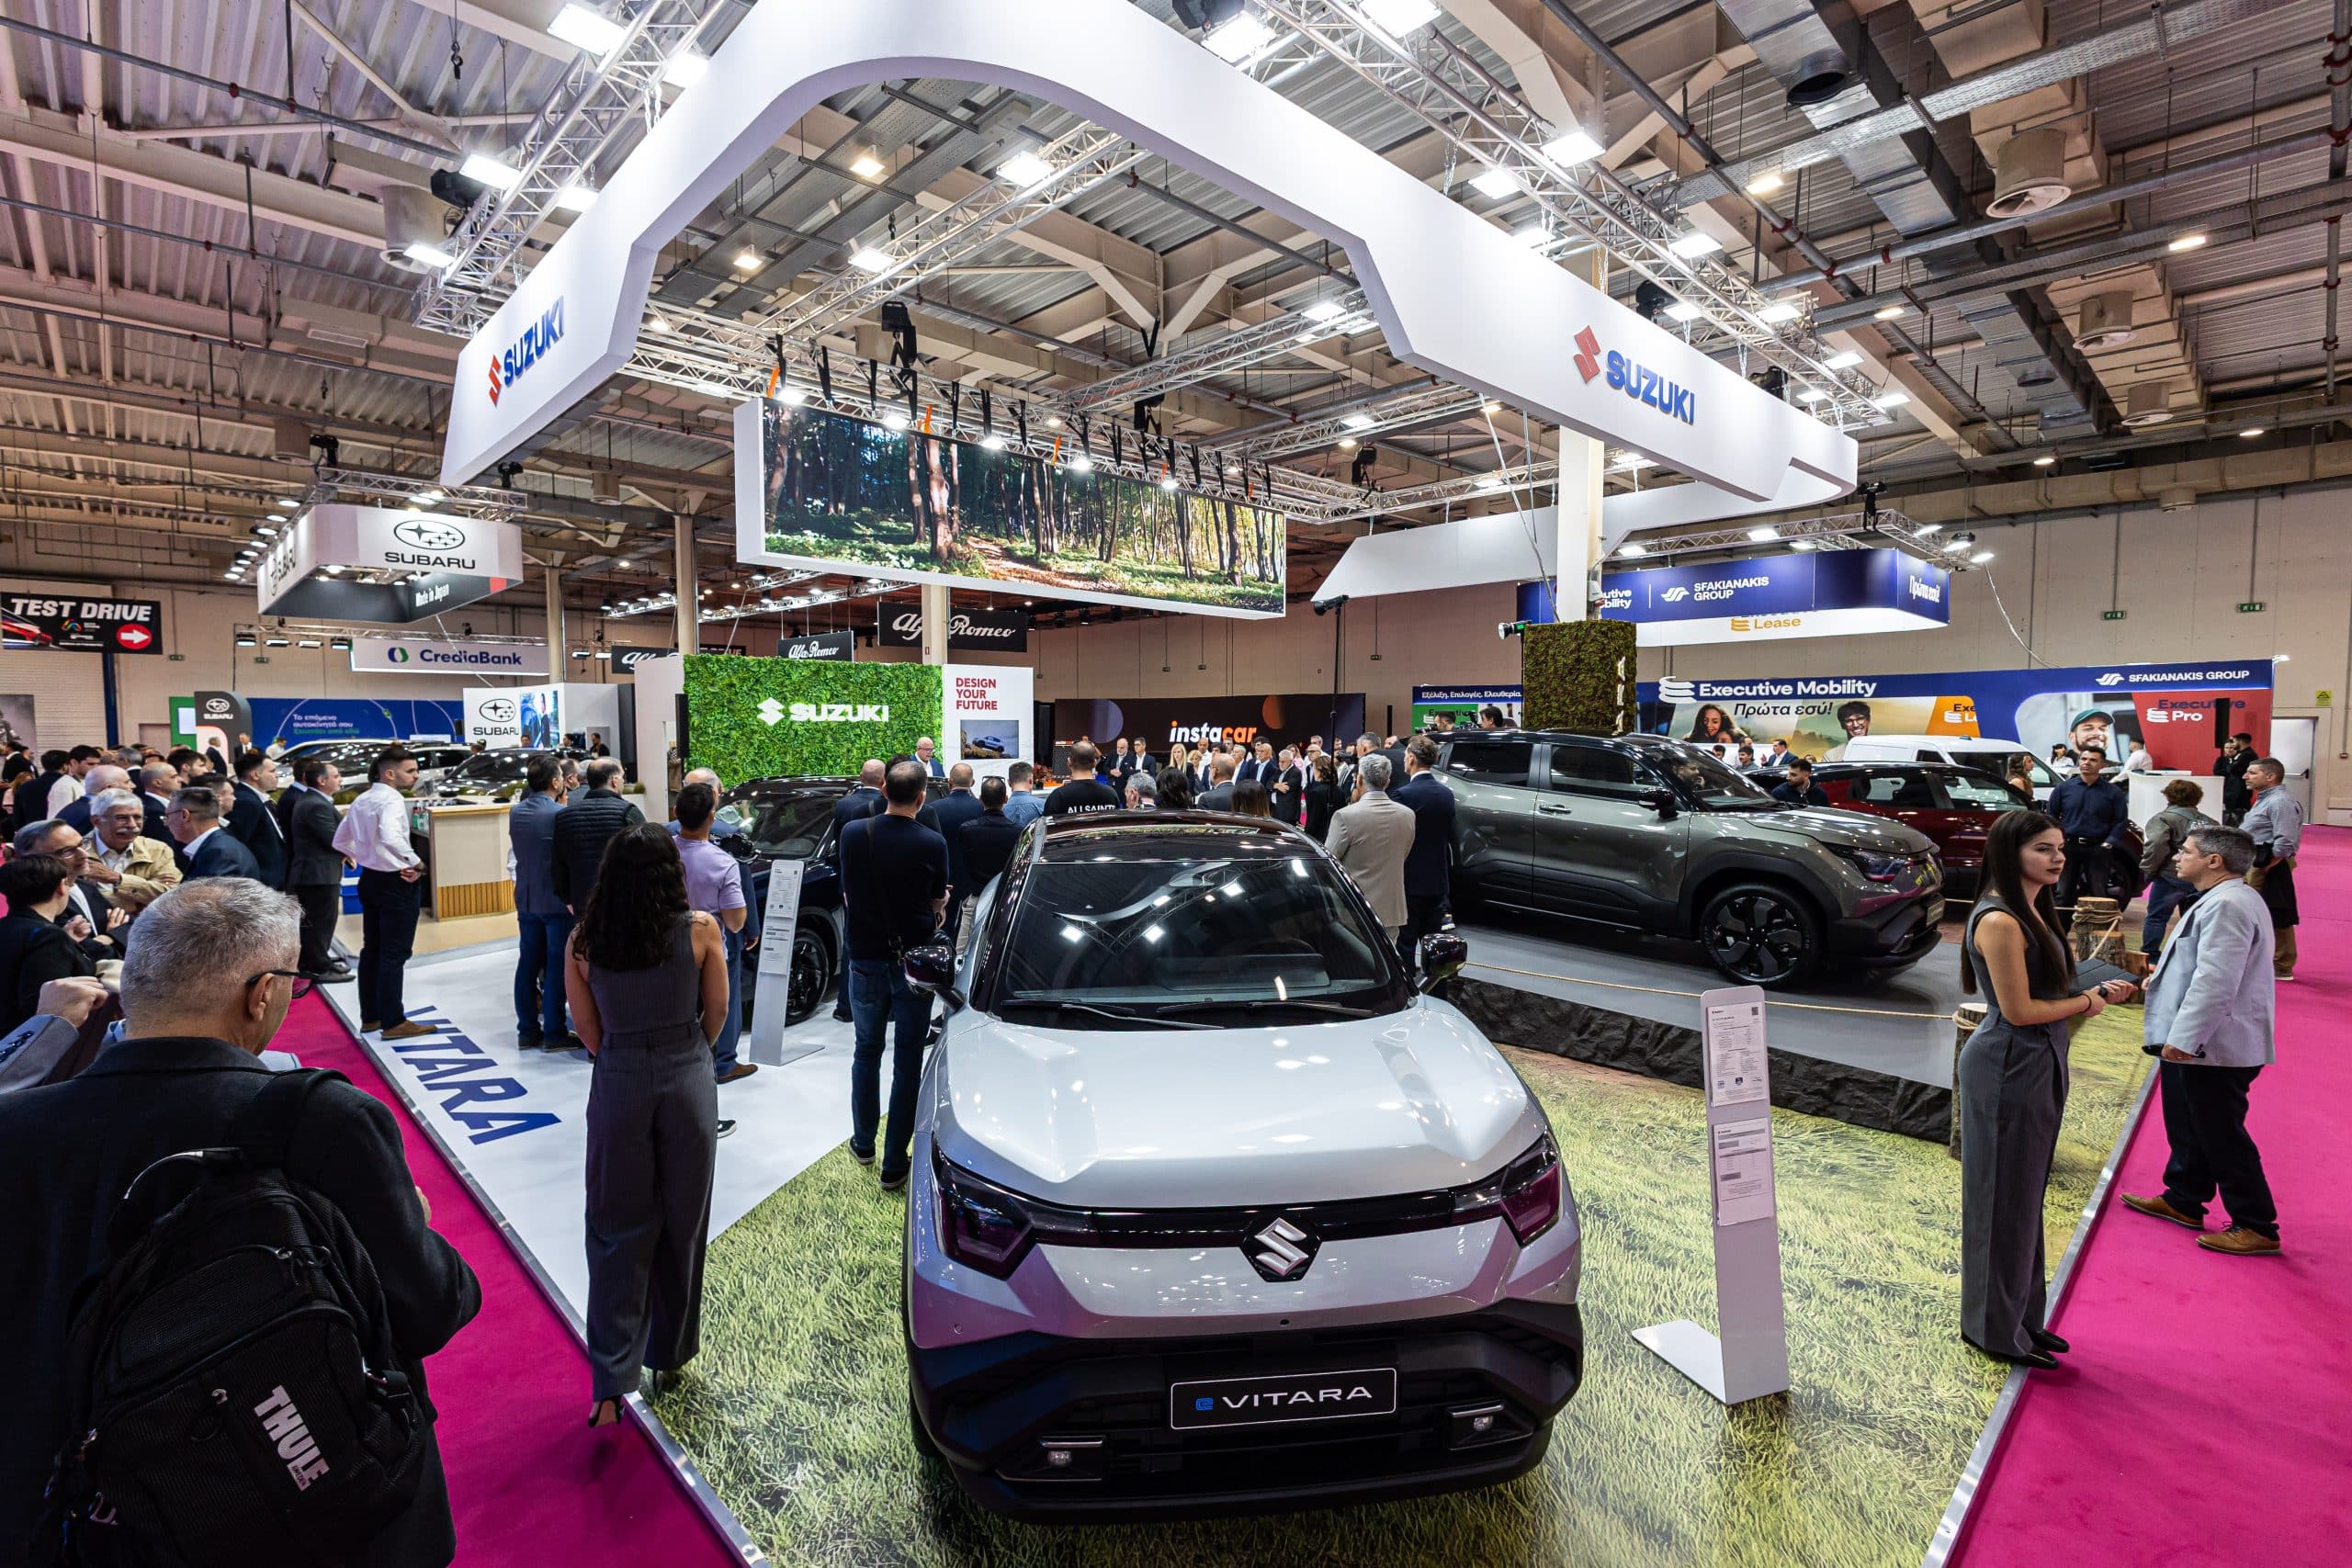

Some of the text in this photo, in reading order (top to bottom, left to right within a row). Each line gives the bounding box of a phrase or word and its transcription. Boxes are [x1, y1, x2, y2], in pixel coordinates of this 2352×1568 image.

[503, 296, 564, 389] SUZUKI
[1606, 350, 1695, 425] SUZUKI
[385, 552, 476, 570] SUBARU
[1694, 577, 1770, 592] SFAKIANAKIS
[1694, 590, 1734, 601] GROUP
[11, 599, 153, 622] TEST DRIVE
[949, 615, 1015, 637] Romeo
[1754, 616, 1801, 630] Lease
[420, 649, 522, 665] CrediaBank
[788, 640, 839, 659] Alfa Romeo
[956, 678, 997, 688] DESIGN
[2129, 671, 2250, 682] SFAKIANAKIS GROUP
[956, 689, 986, 699] YOUR
[1421, 691, 1449, 699] Εξέλιξη.
[1450, 691, 1483, 699] Επιλογές.
[1700, 679, 1877, 698] Executive Mobility
[789, 703, 888, 722] SUZUKI
[956, 700, 998, 710] FUTURE
[1734, 702, 1834, 718] Πρώτα εσύ!
[2172, 710, 2202, 722] Pro
[473, 727, 519, 736] SUBARU
[1170, 720, 1257, 743] instacar
[1222, 1386, 1373, 1408] VITARA
[254, 1384, 330, 1492] THULE
